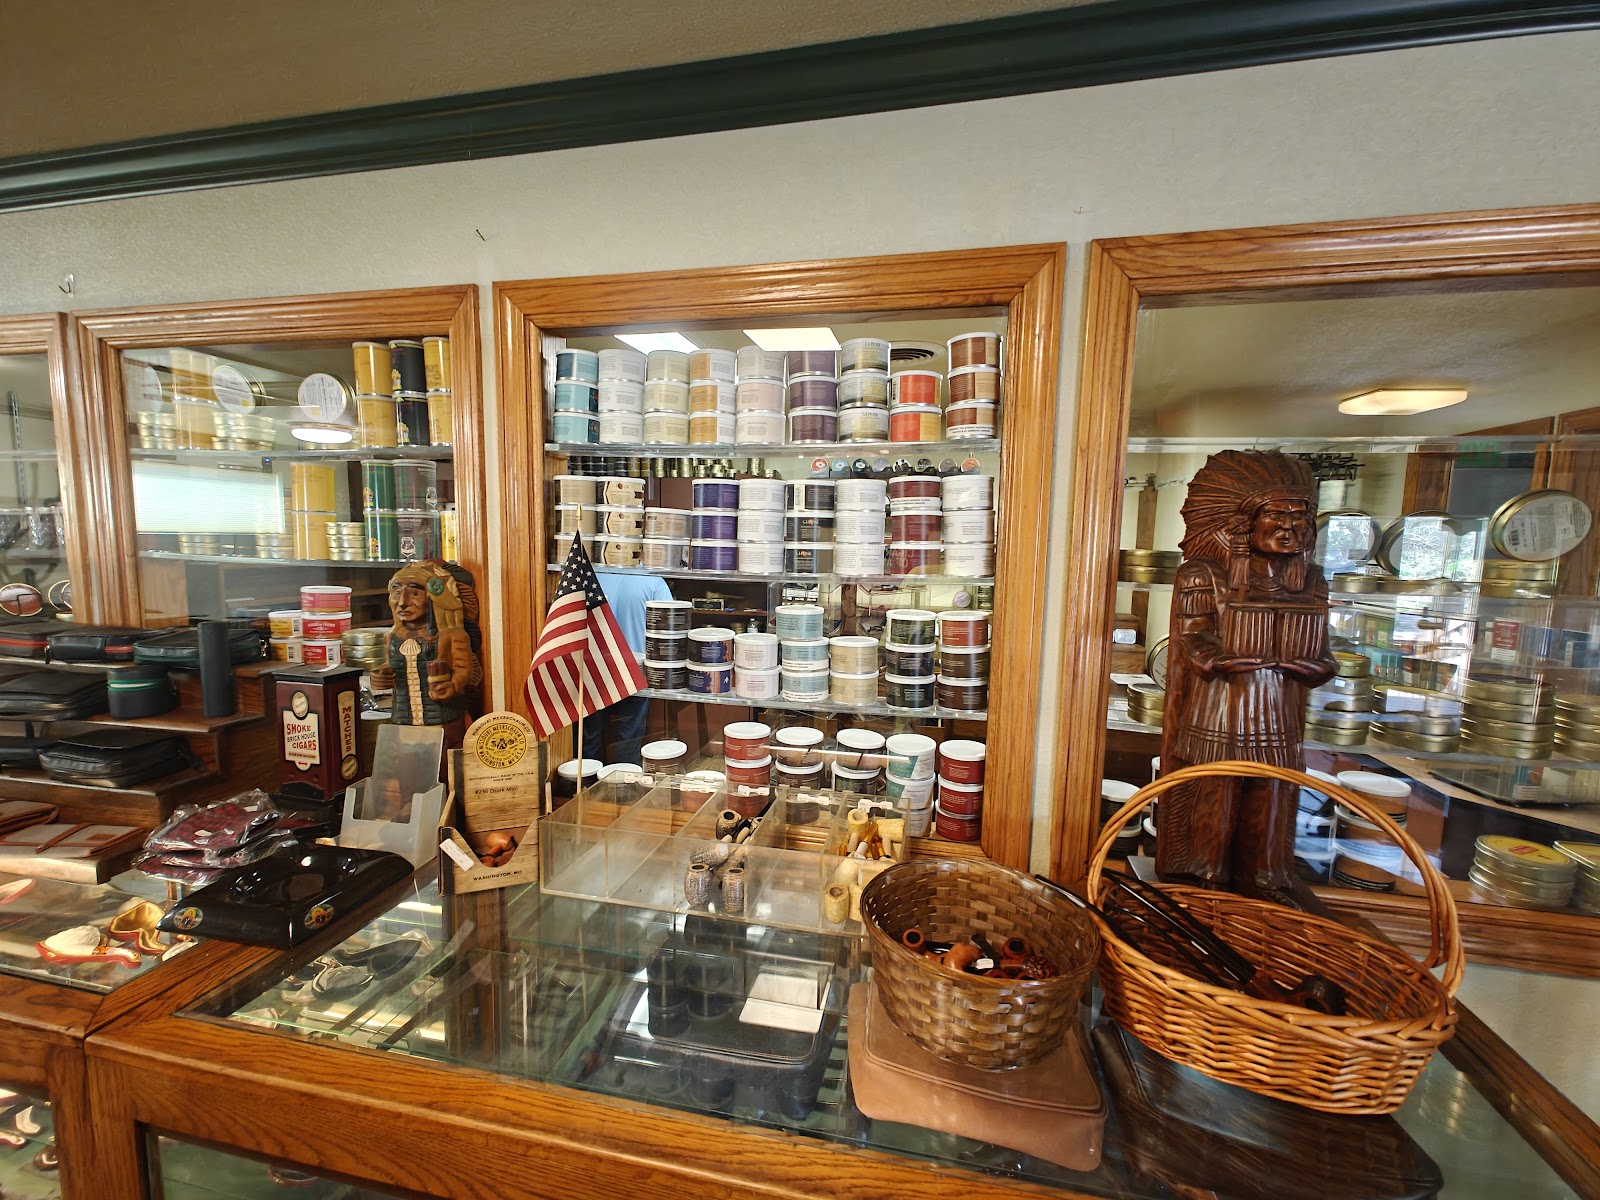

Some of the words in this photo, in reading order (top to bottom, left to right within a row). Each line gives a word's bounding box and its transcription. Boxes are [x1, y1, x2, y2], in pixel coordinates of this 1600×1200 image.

[287, 724, 311, 735] SMOKE
[342, 706, 351, 752] MATCHES
[287, 734, 300, 742] BRICK
[301, 732, 316, 741] HOUSE
[292, 740, 316, 750] CIGARS
